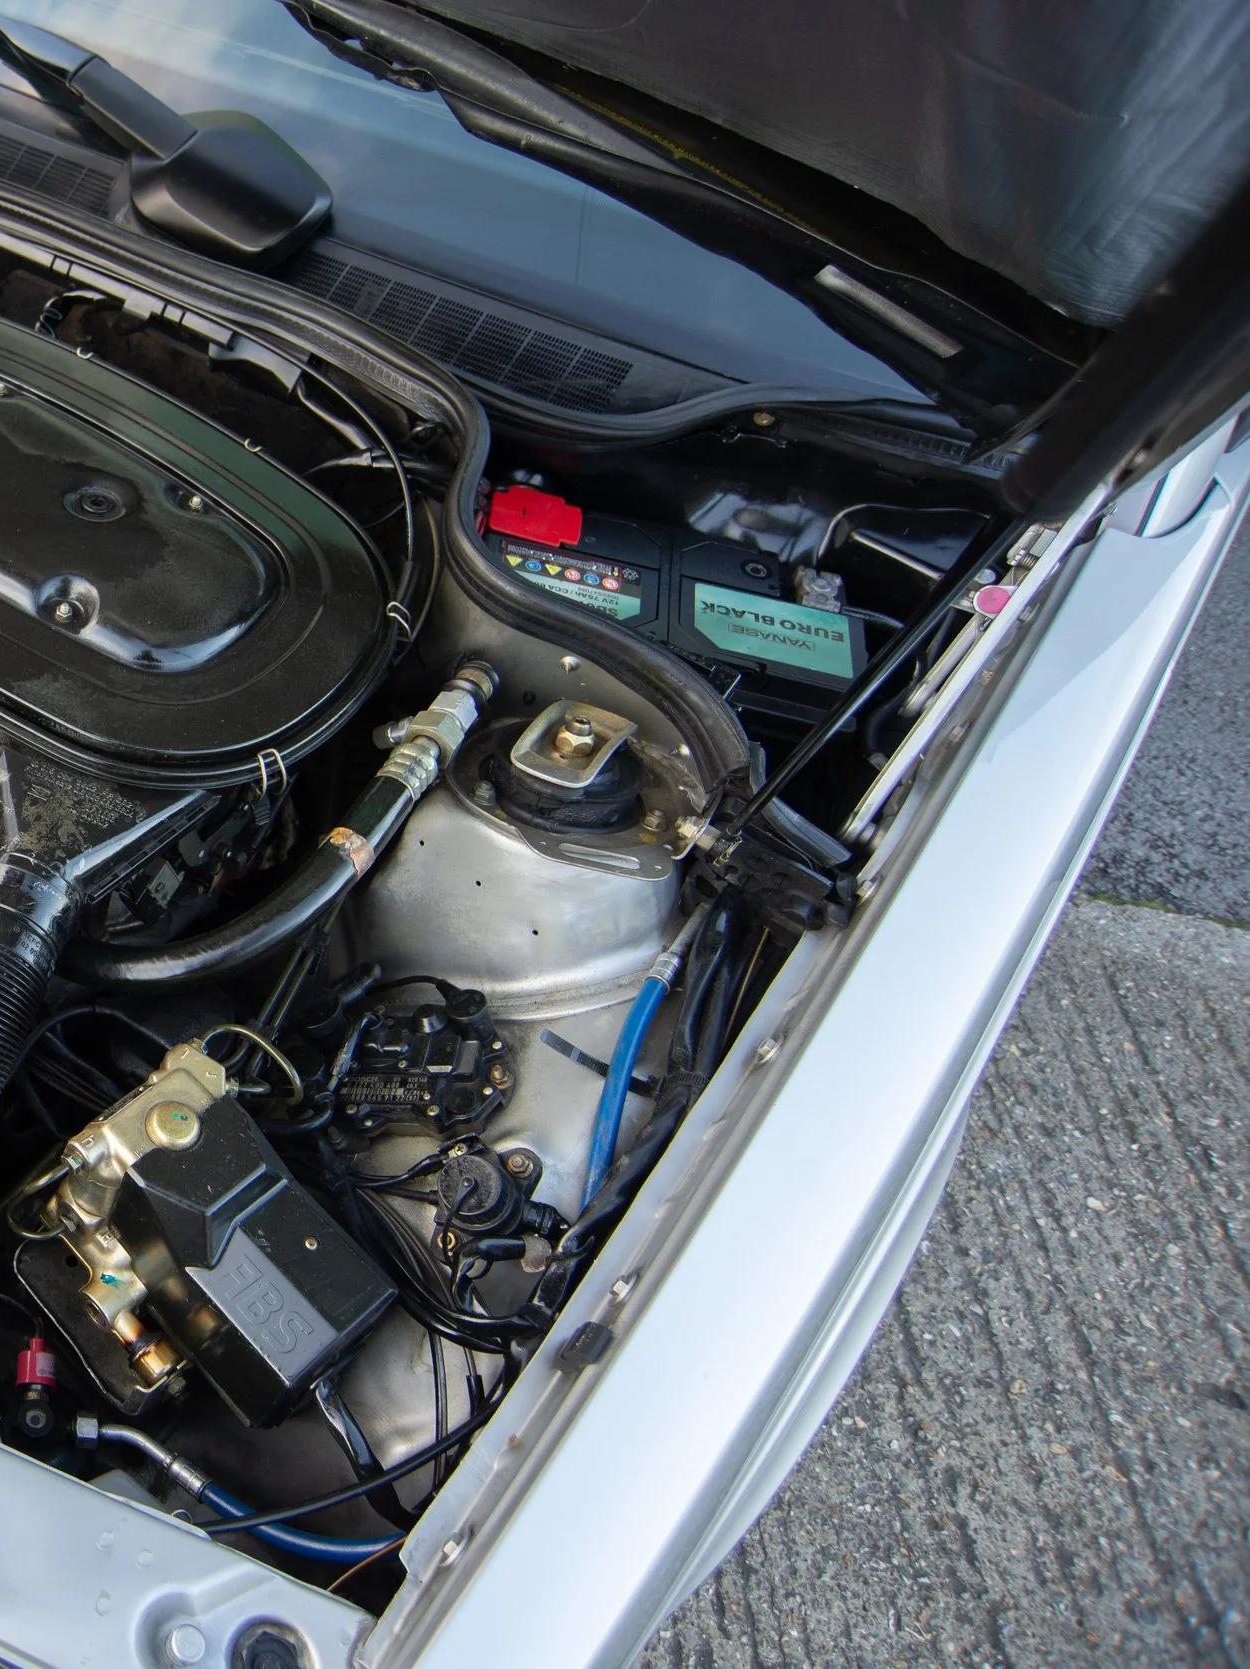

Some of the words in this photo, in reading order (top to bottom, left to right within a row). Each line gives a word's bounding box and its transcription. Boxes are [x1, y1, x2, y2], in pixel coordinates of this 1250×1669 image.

[546, 584, 569, 594] CCA
[573, 590, 599, 602] 75Ah
[600, 597, 620, 606] 12V
[698, 600, 776, 627] BLACK
[730, 623, 813, 651] YANASE
[777, 617, 845, 643] EURO
[211, 1252, 316, 1360] ABS
